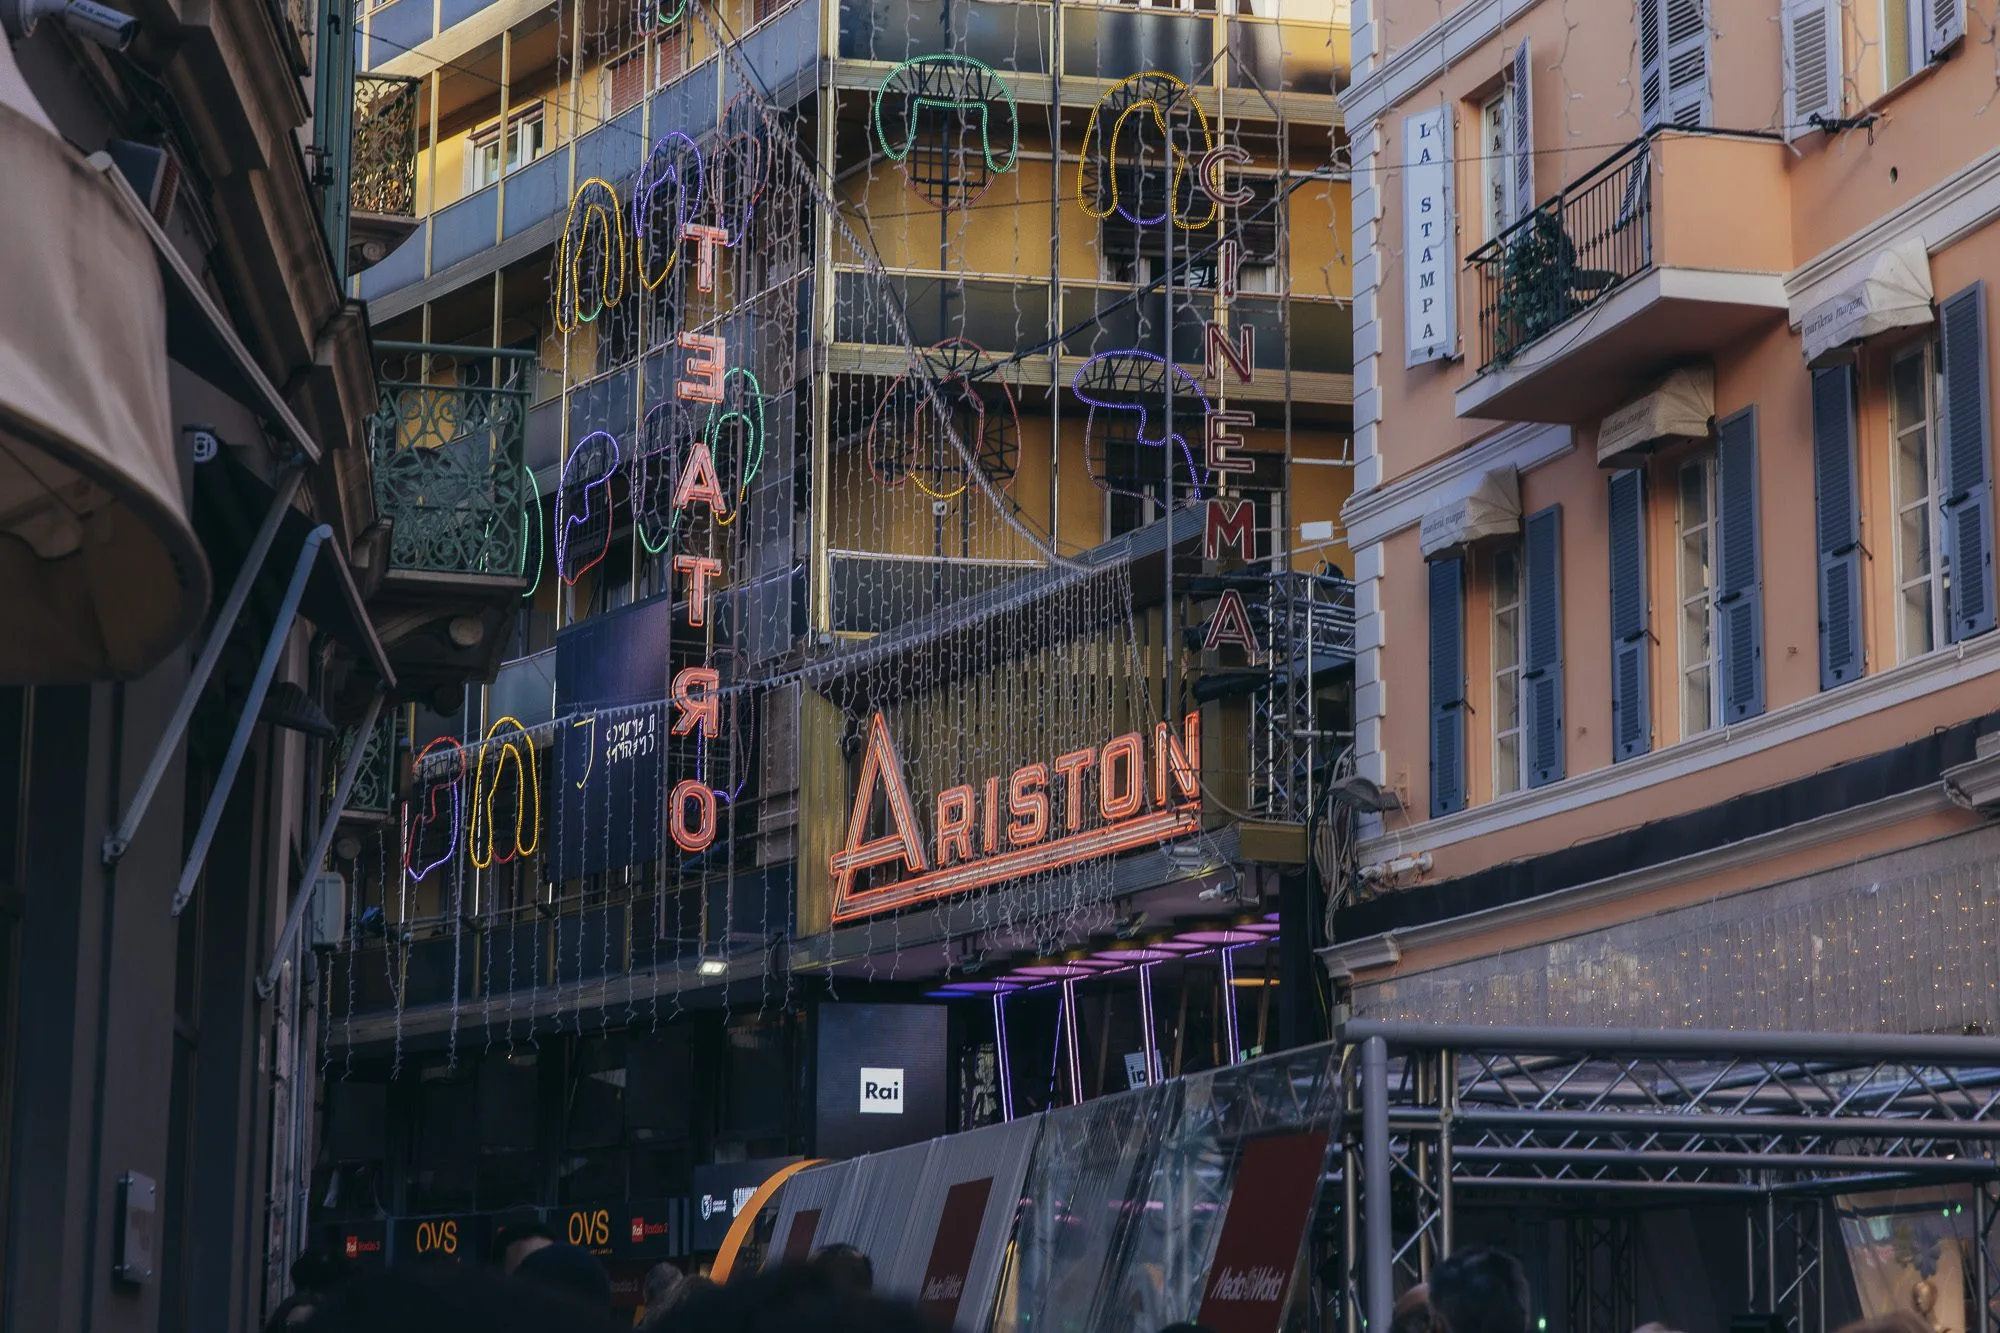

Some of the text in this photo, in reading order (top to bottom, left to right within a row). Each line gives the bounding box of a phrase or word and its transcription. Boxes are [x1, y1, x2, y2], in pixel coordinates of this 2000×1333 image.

[1419, 123, 1435, 339] LA STAMPA
[1199, 144, 1260, 653] CINEMA
[831, 711, 1200, 922] ARISTON
[865, 1081, 899, 1100] Rai
[416, 1220, 458, 1255] OVS
[568, 1209, 610, 1246] OVS
